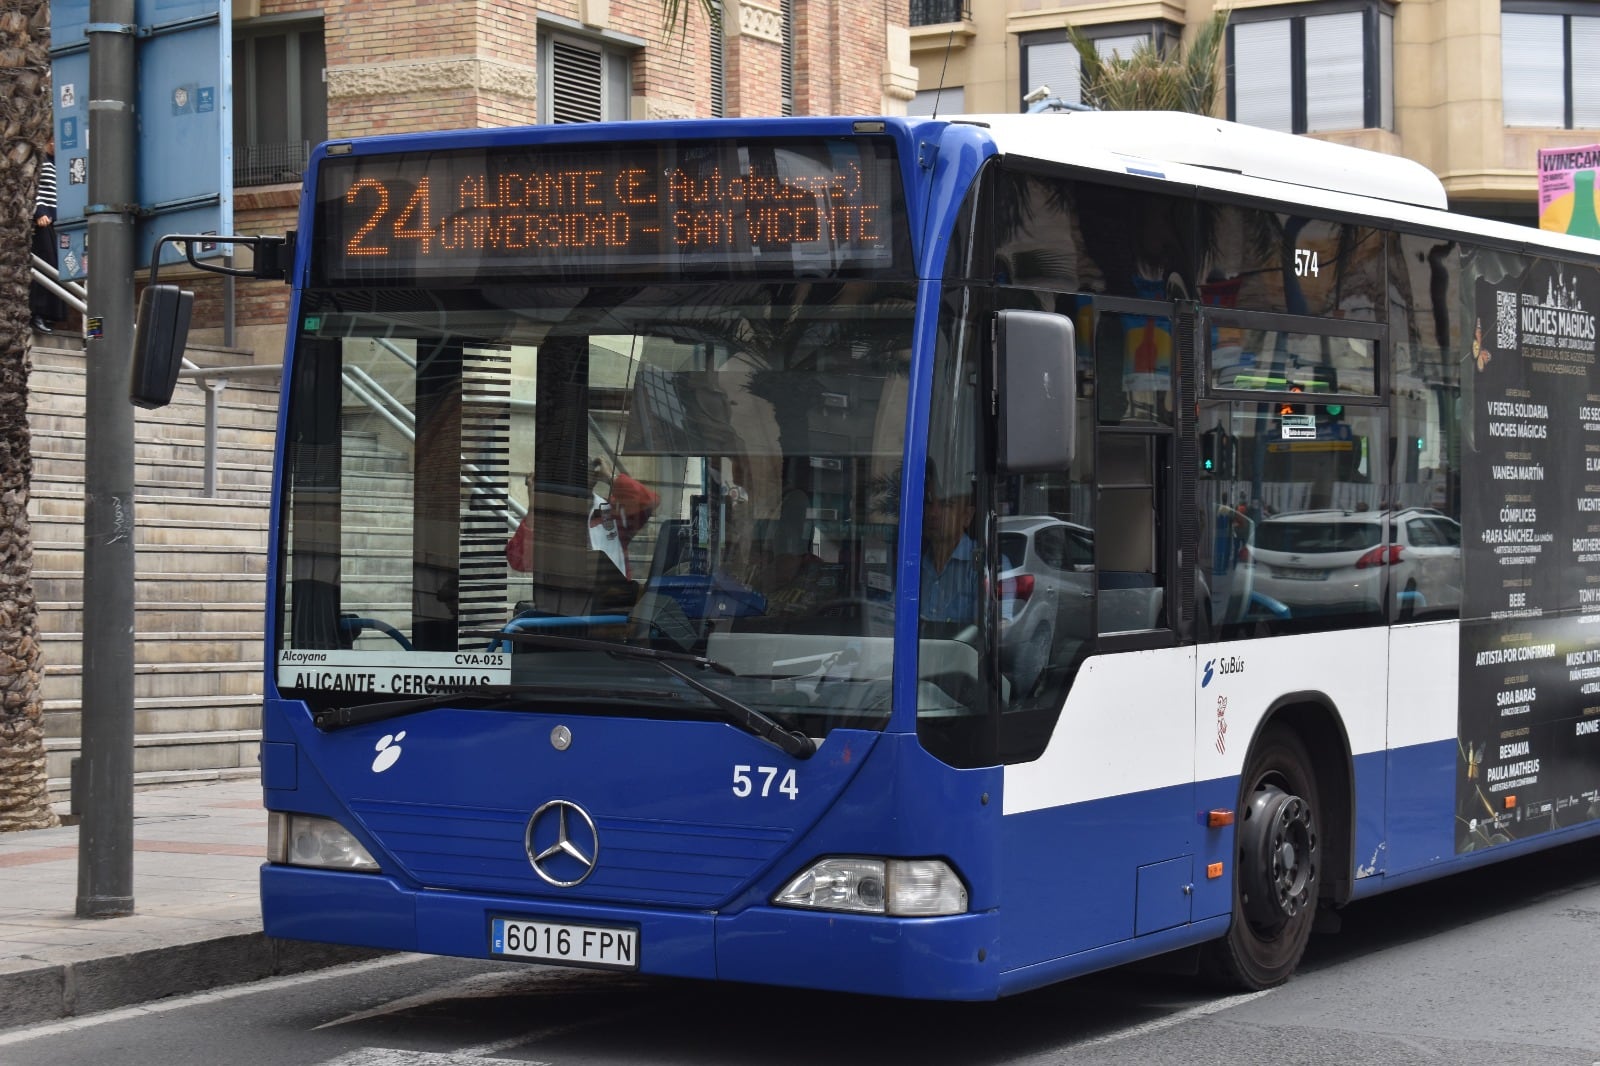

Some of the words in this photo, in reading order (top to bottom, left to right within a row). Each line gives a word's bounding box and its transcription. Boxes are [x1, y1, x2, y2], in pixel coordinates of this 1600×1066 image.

[460, 171, 603, 208] ALICANTE
[615, 168, 657, 203] (E.
[669, 161, 861, 202] Autobuses)
[347, 177, 436, 255] 24
[441, 212, 630, 249] UNIVERSIDAD
[673, 209, 732, 244] SAN
[746, 205, 880, 243] VICENTE
[1294, 249, 1319, 277] 574
[1522, 307, 1557, 334] NOCHES
[1558, 312, 1595, 339] MAGICAS
[1487, 401, 1493, 415] V
[1494, 402, 1514, 417] FIESTA
[1515, 403, 1548, 419] SOLIDARIA
[1579, 407, 1590, 420] LOS
[1489, 422, 1517, 437] NOCHES
[1517, 420, 1547, 439] MÁGICAS
[1492, 465, 1518, 480] VANESA
[1519, 462, 1544, 480] MARTÍN
[1500, 505, 1536, 522] CÓMPLICES
[1503, 525, 1534, 543] SÁNCHEZ
[1509, 593, 1526, 607] BEBE
[1579, 588, 1594, 603] TONY
[282, 651, 327, 664] Alcoyana
[454, 654, 504, 666] CVA-025
[1475, 649, 1503, 666] ARTISTA
[1504, 647, 1518, 663] POR
[1518, 643, 1555, 661] CONFIRMAR
[1566, 651, 1586, 666] MUSIC
[1586, 650, 1593, 664] IN
[1219, 656, 1245, 674] SuBús
[1569, 667, 1581, 681] IVÁN
[295, 673, 376, 693] ALICANTE
[1497, 691, 1514, 706] SARA
[1515, 688, 1536, 704] BARAS
[1576, 719, 1599, 735] BONNIE
[1499, 741, 1529, 759] BESMAYA
[1487, 765, 1509, 782] PAULA
[1509, 759, 1540, 778] MATHEUS
[732, 764, 799, 800] 574
[495, 939, 502, 948] E
[507, 924, 571, 955] 6016
[582, 931, 631, 961] FPN
